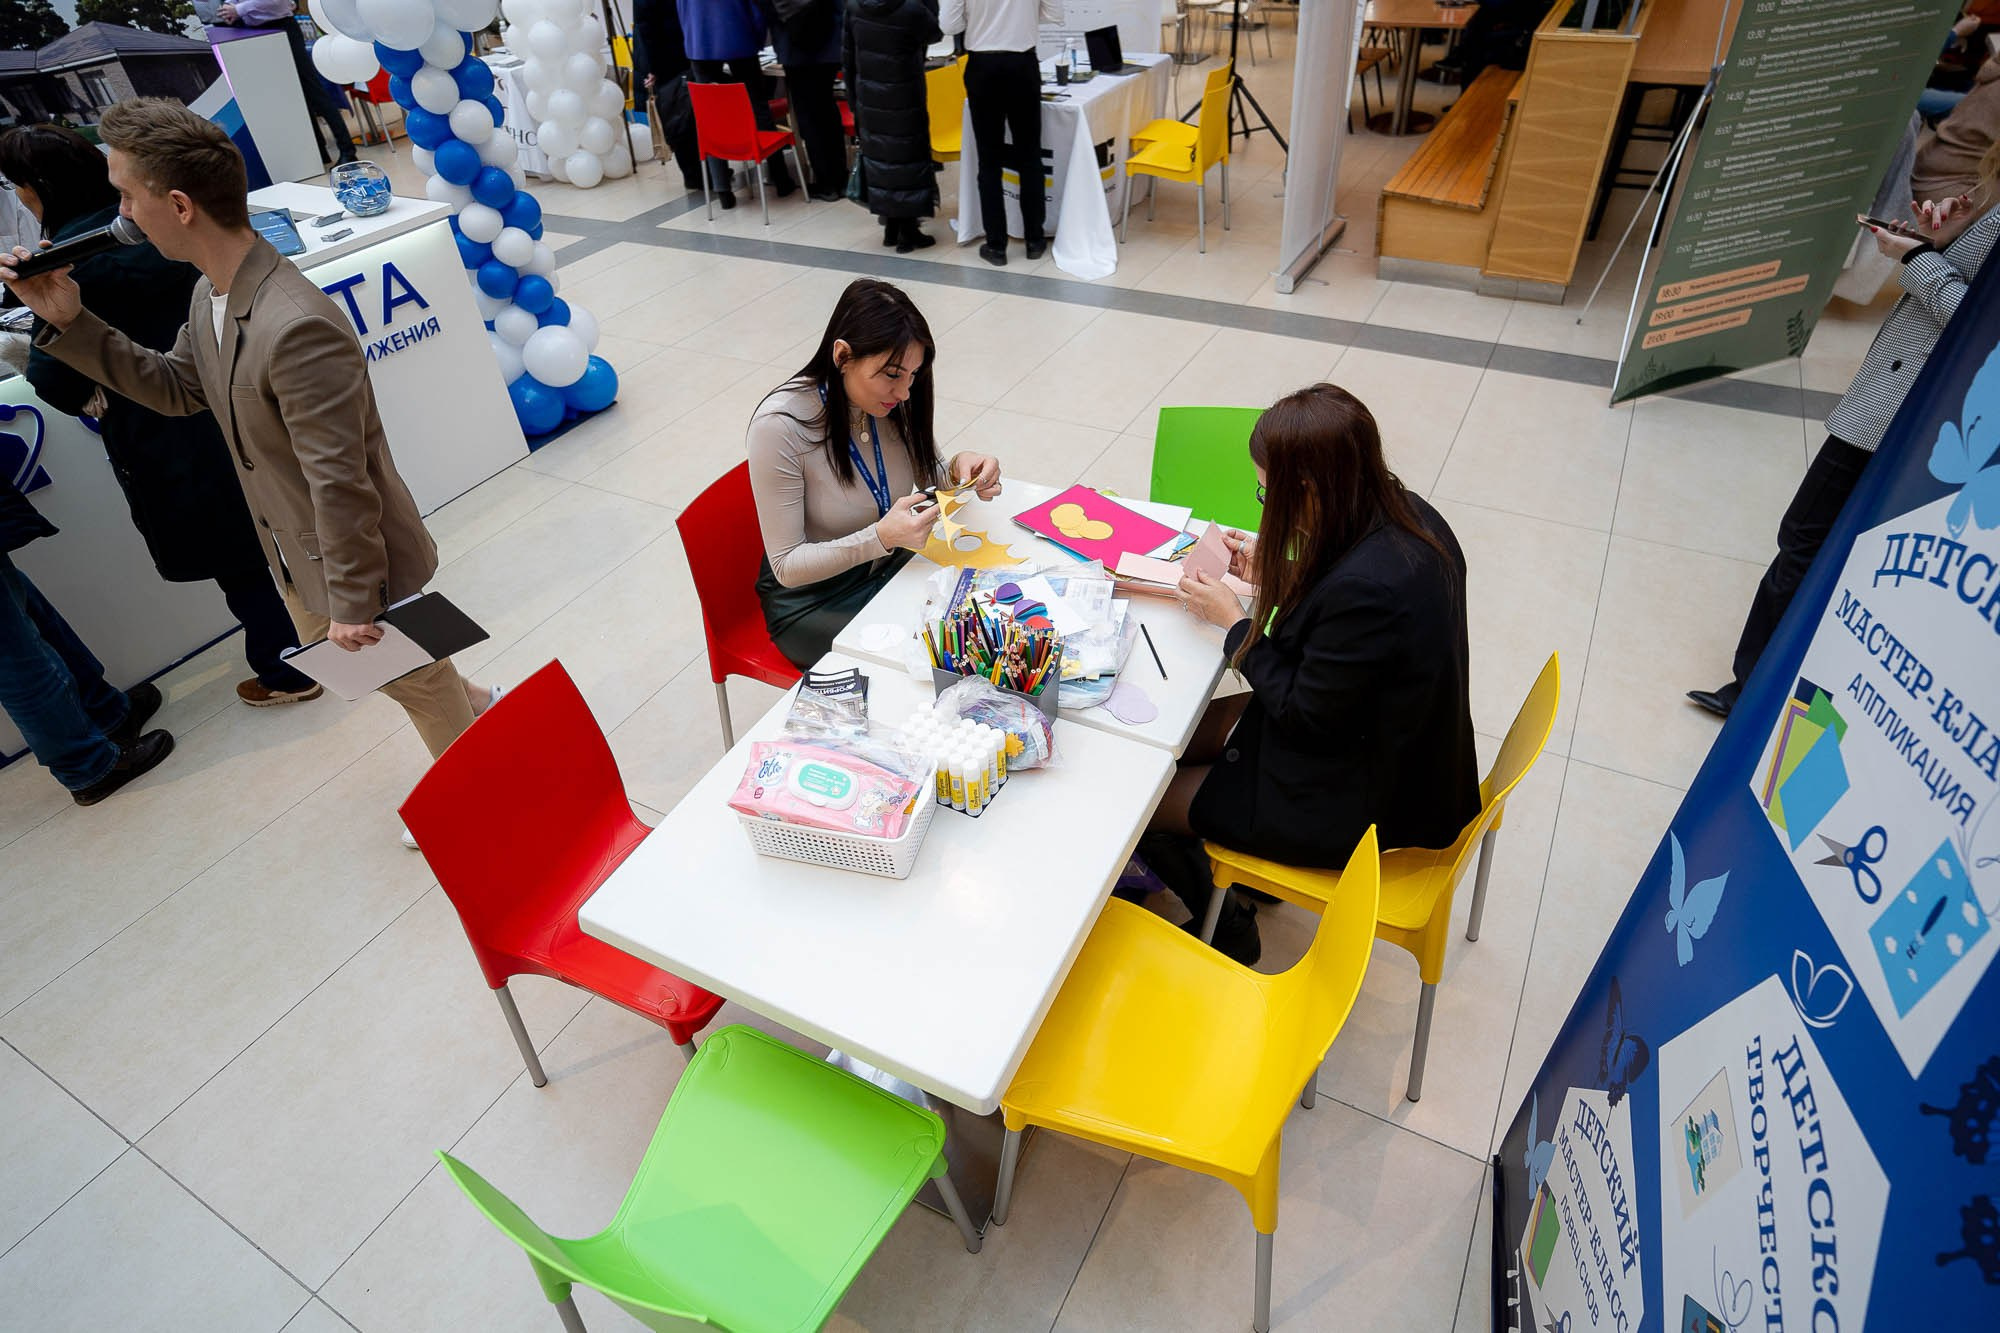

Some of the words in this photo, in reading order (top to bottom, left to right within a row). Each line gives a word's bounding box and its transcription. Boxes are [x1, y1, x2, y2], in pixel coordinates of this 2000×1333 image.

[1835, 588, 2000, 782] МАСТЕР-КЛА
[1847, 672, 1976, 826] АППЛИКАЦИЯ
[1559, 1124, 1628, 1333] МАСТЕР-КЛАСС
[1560, 1193, 1582, 1268] ЛОВЕЦ
[1579, 1260, 1599, 1327] СНОВ
[1573, 1098, 1640, 1280] ДЕТСКИЙ
[1746, 1035, 1784, 1333] ТВОРЧЕСТ
